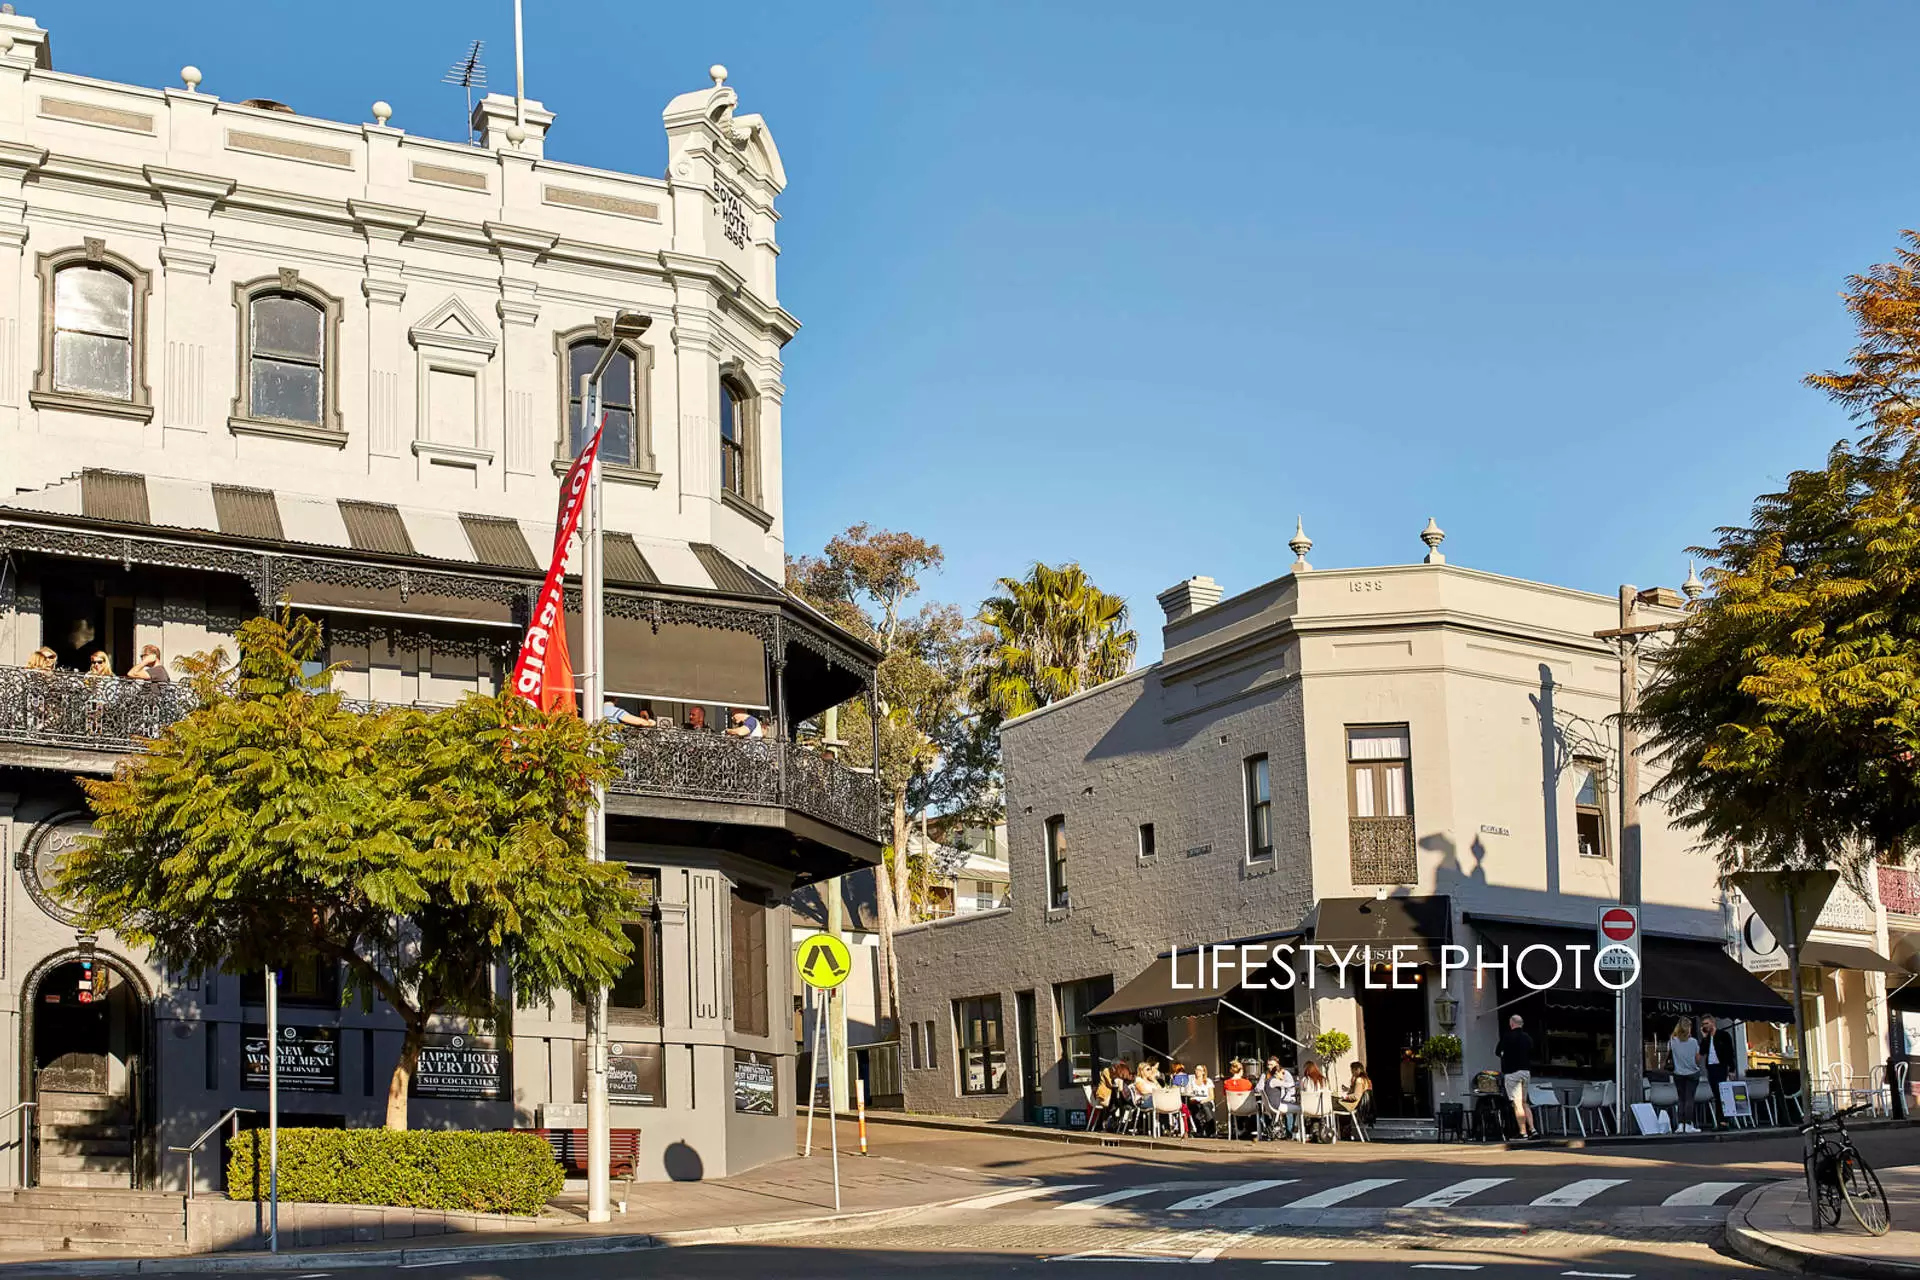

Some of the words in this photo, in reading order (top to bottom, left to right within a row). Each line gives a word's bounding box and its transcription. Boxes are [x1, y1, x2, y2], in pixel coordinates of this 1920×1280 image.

[714, 181, 745, 220] ROYAL
[723, 205, 752, 242] HOTEL
[1602, 955, 1634, 965] ENTRY
[1658, 1000, 1693, 1013] GUSTO
[276, 1046, 305, 1056] NEW
[299, 1056, 334, 1067] MENU
[418, 1051, 458, 1062] HAPPY
[463, 1053, 499, 1064] HOUR
[417, 1061, 465, 1073] EVERY
[470, 1064, 499, 1075] DAY
[441, 1077, 494, 1086] COCKTAILS
[609, 1083, 638, 1091] FINALIST
